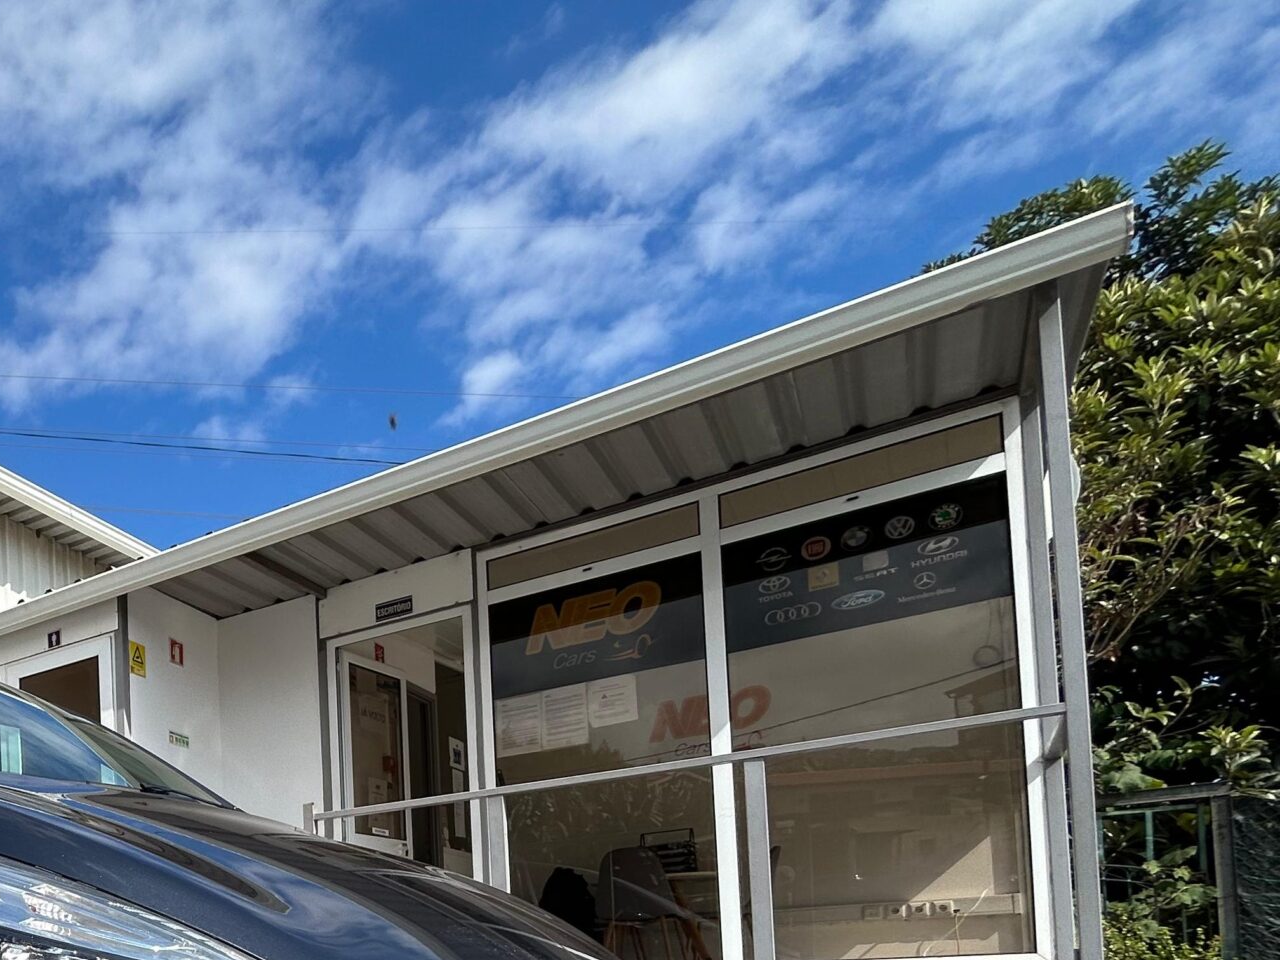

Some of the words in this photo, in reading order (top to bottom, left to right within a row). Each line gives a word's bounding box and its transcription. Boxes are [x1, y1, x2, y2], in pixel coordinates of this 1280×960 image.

[911, 550, 968, 568] HYUNDAI
[759, 591, 793, 603] TOYOTA
[377, 601, 411, 617] ESCRITÓRIO
[525, 580, 661, 656] NEO
[553, 649, 597, 669] Cars
